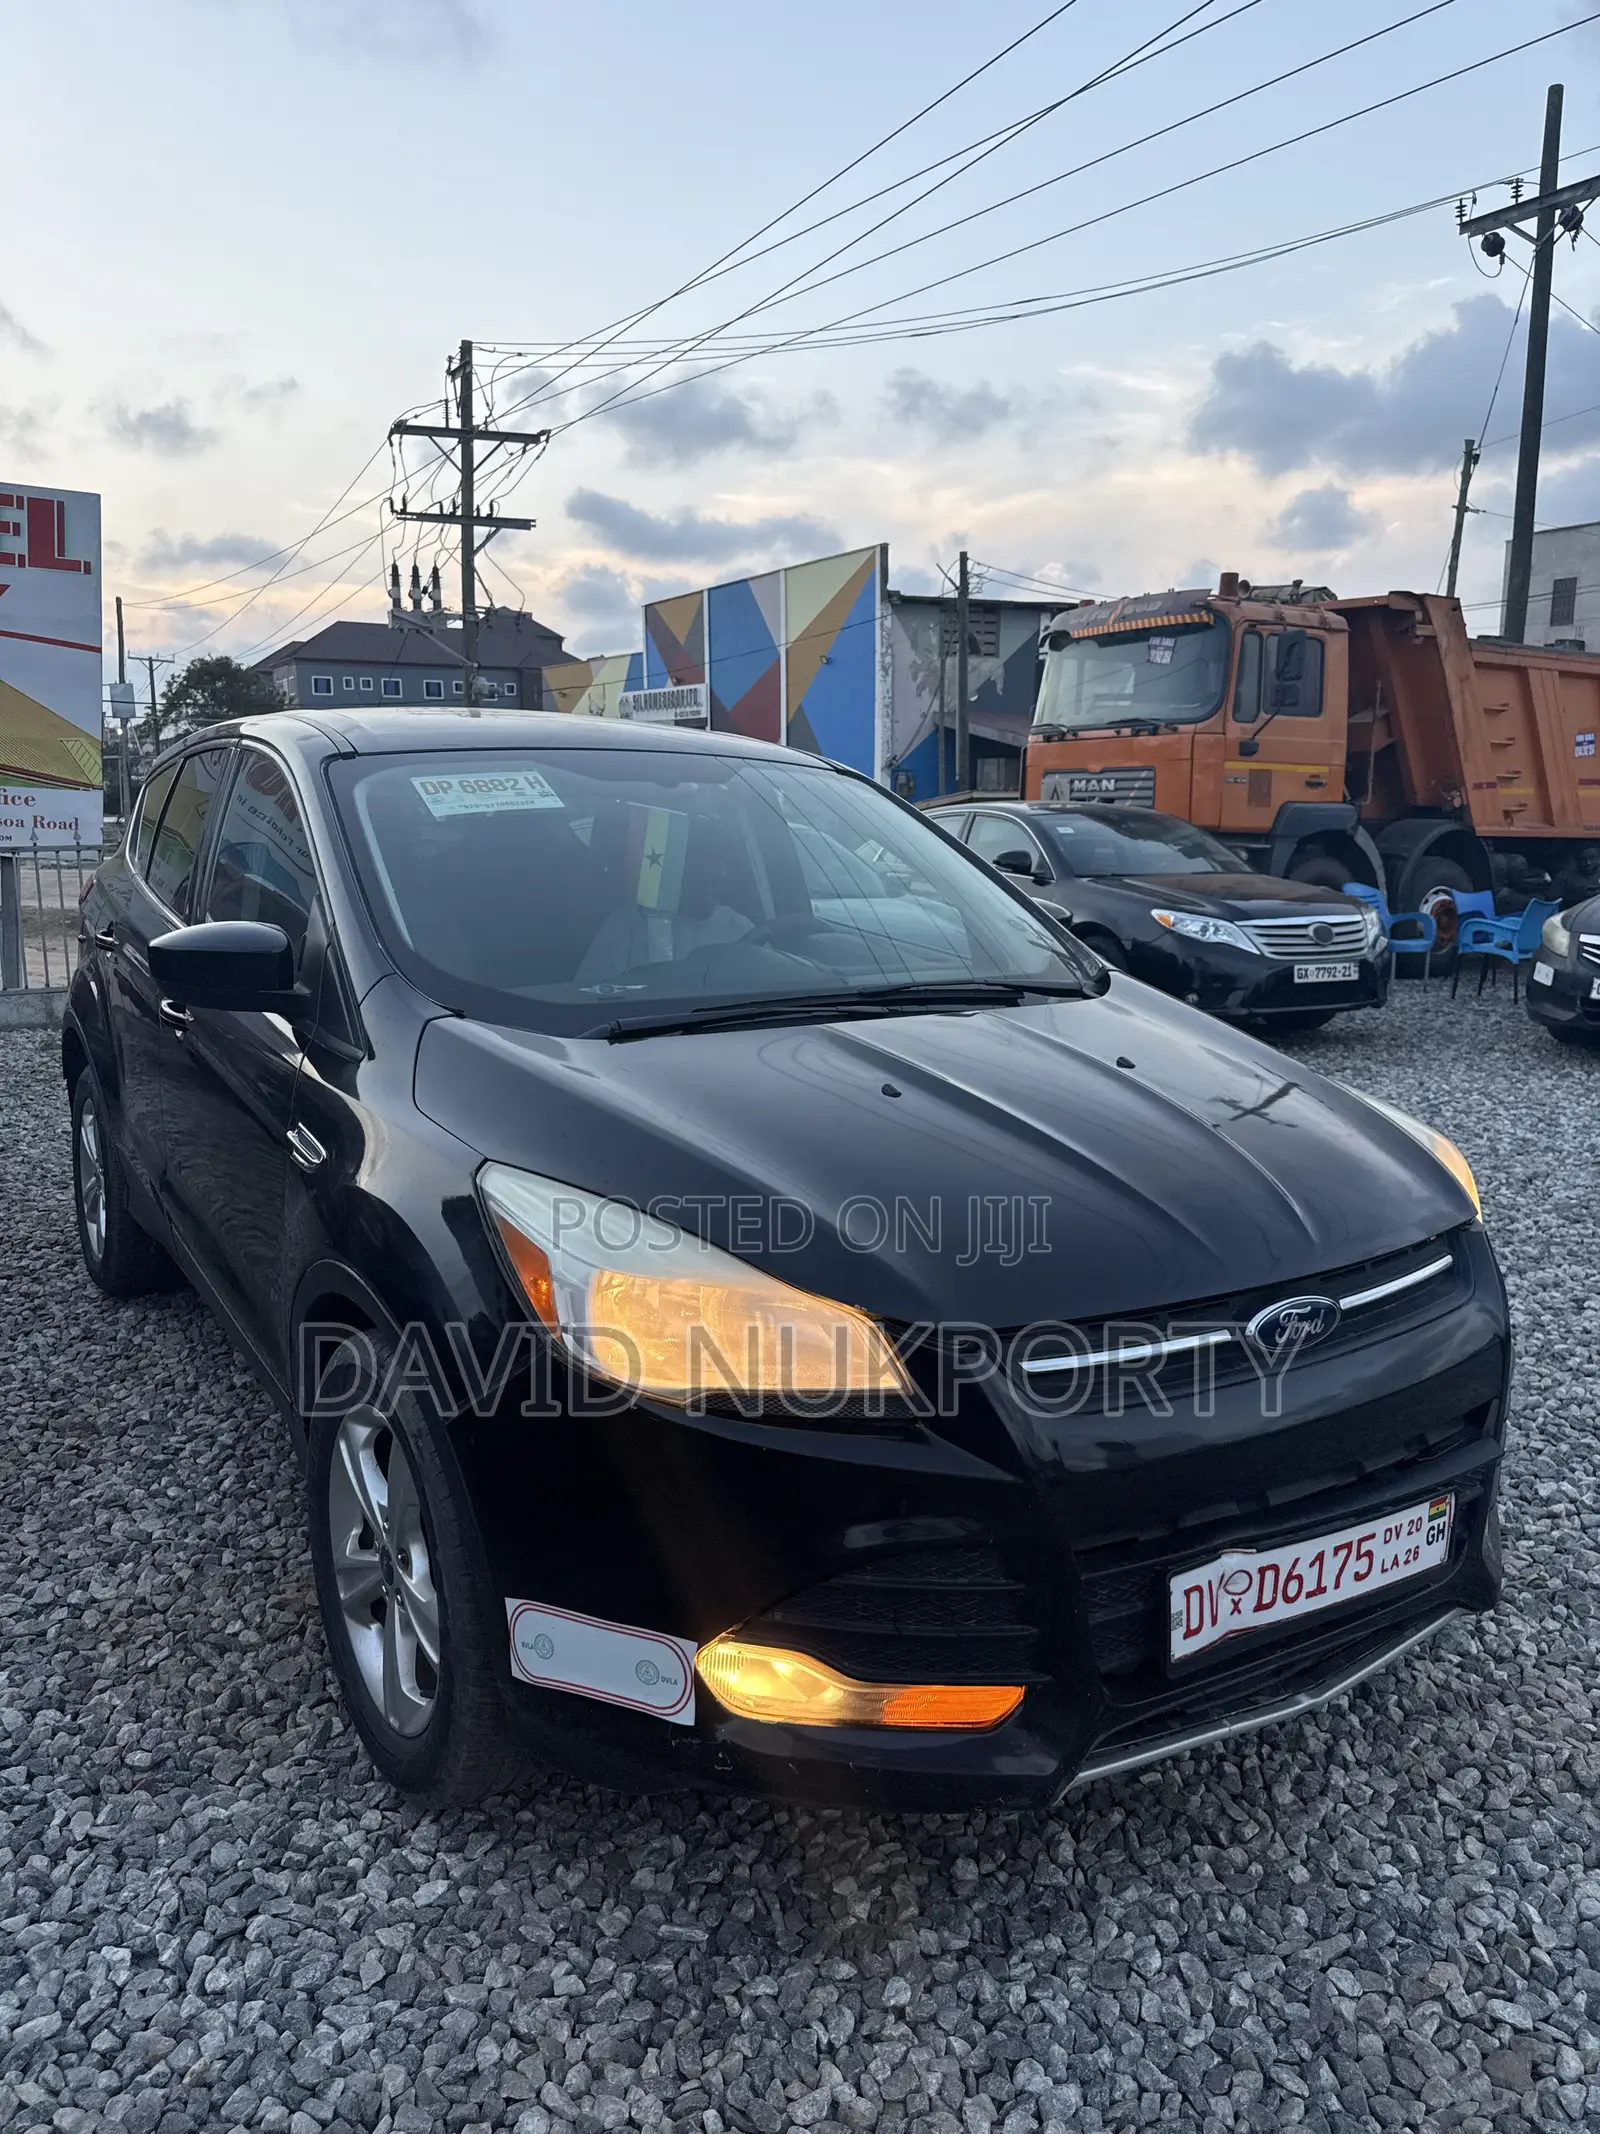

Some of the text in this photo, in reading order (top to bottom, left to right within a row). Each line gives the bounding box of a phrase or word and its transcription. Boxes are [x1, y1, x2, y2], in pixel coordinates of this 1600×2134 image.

[419, 780, 453, 796] DP
[458, 777, 525, 794] 6882
[523, 776, 546, 790] H
[1072, 778, 1117, 792] MAN
[0, 787, 37, 807] ice
[32, 814, 80, 831] Road
[1296, 965, 1352, 980] GX 7792-21
[1274, 1305, 1325, 1344] Ford
[1382, 1515, 1423, 1545] DV 20
[1426, 1520, 1446, 1546] GH
[1380, 1544, 1420, 1574] LA 26
[1183, 1572, 1226, 1641] DV
[1253, 1532, 1377, 1613] D6175
[660, 1675, 679, 1687] DVLA
